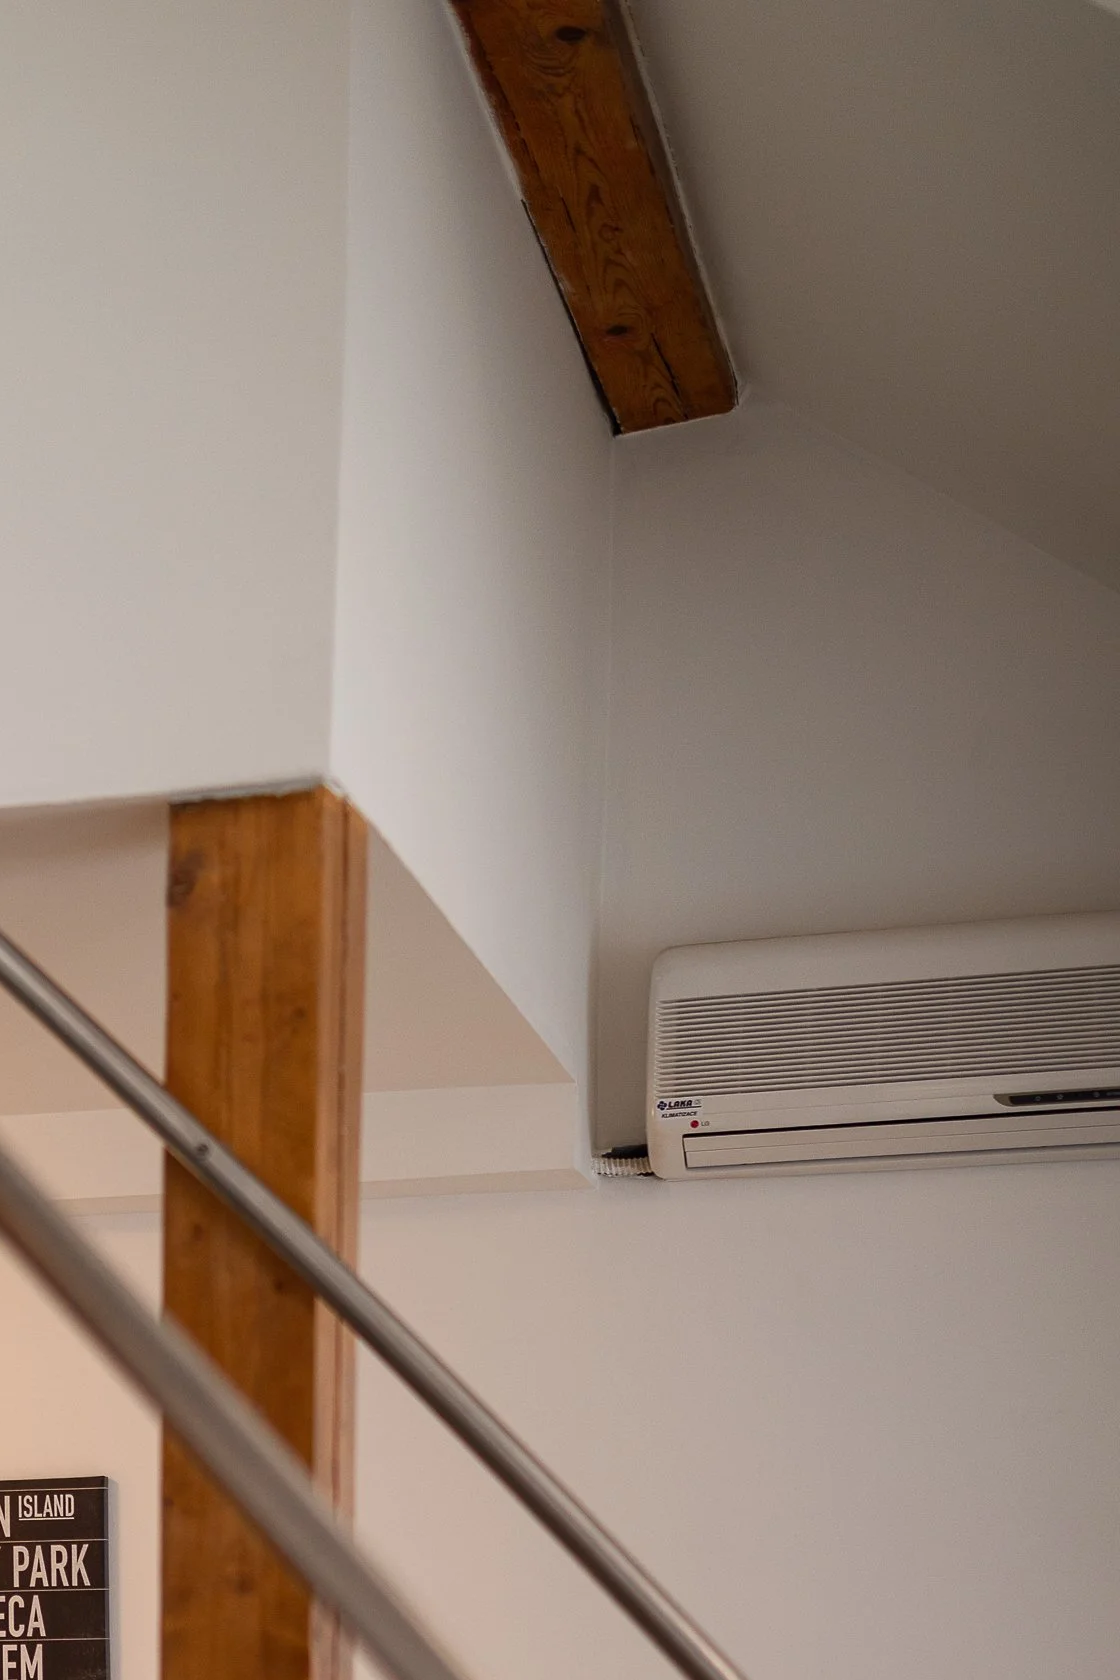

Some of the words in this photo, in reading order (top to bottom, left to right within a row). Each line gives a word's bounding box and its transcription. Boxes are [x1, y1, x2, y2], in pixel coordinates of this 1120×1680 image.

[668, 1100, 693, 1108] LAKA
[18, 1494, 75, 1518] ISLAND
[12, 1544, 91, 1588] PARK
